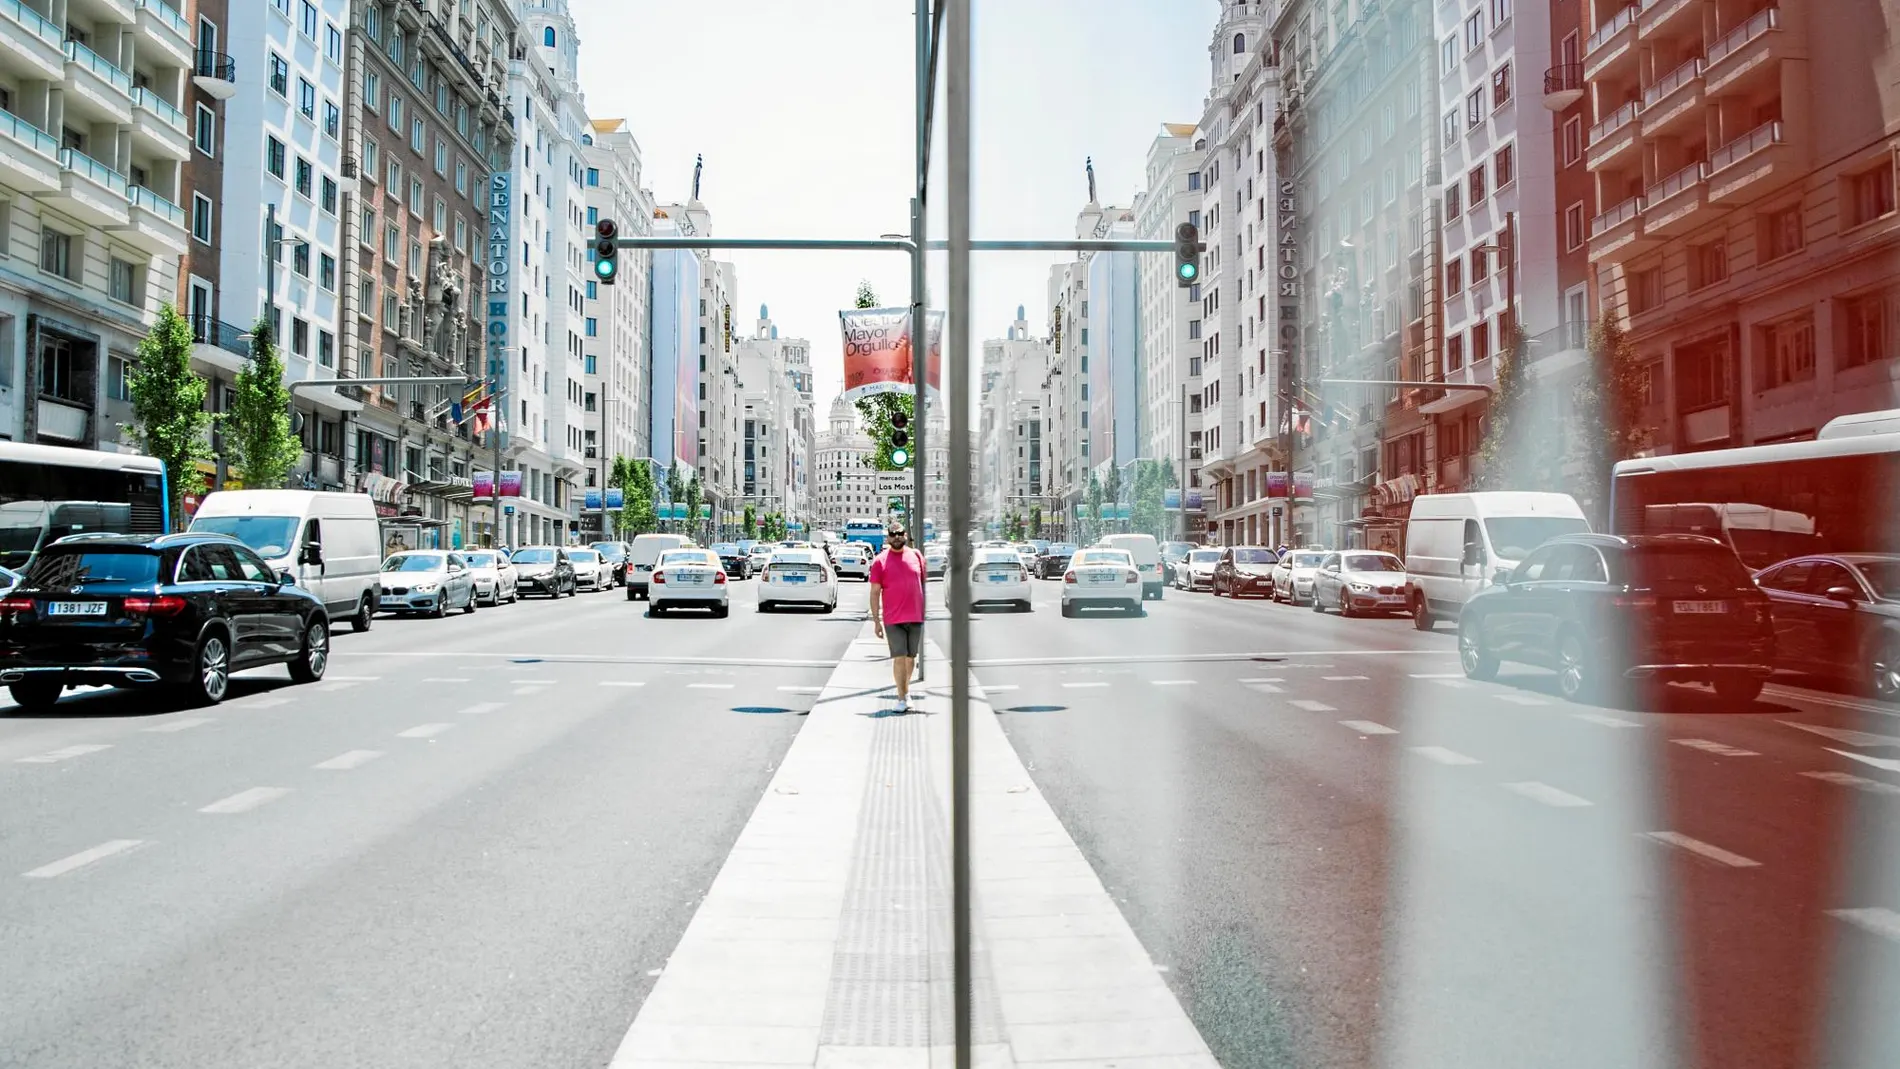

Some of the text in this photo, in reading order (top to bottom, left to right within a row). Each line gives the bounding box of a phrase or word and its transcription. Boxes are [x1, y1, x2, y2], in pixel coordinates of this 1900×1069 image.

[489, 175, 508, 293] SENATOR
[844, 328, 890, 343] Mayor
[846, 340, 898, 357] Orgullo
[878, 483, 893, 491] Los
[57, 603, 104, 613] 1381 JZF
